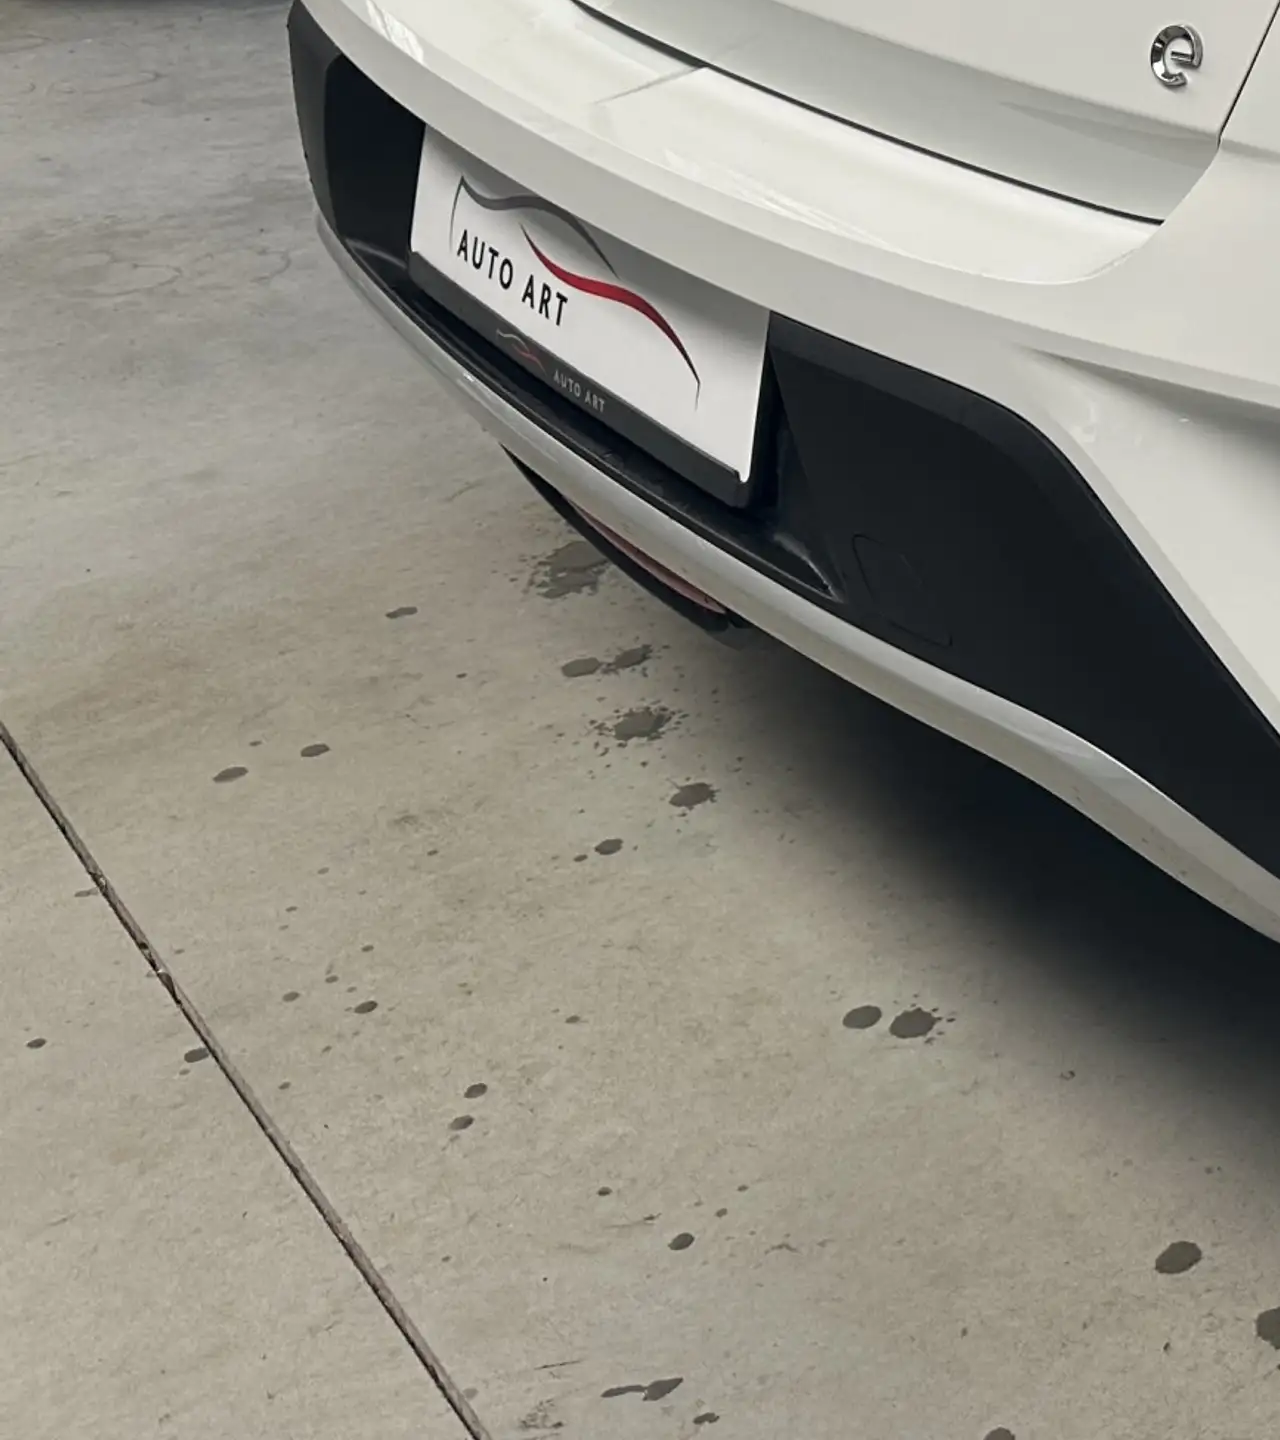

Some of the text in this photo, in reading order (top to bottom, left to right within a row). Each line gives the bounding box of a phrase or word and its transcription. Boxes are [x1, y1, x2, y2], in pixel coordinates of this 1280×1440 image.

[457, 229, 569, 327] AUTO ART
[553, 369, 605, 413] AUTO ART
